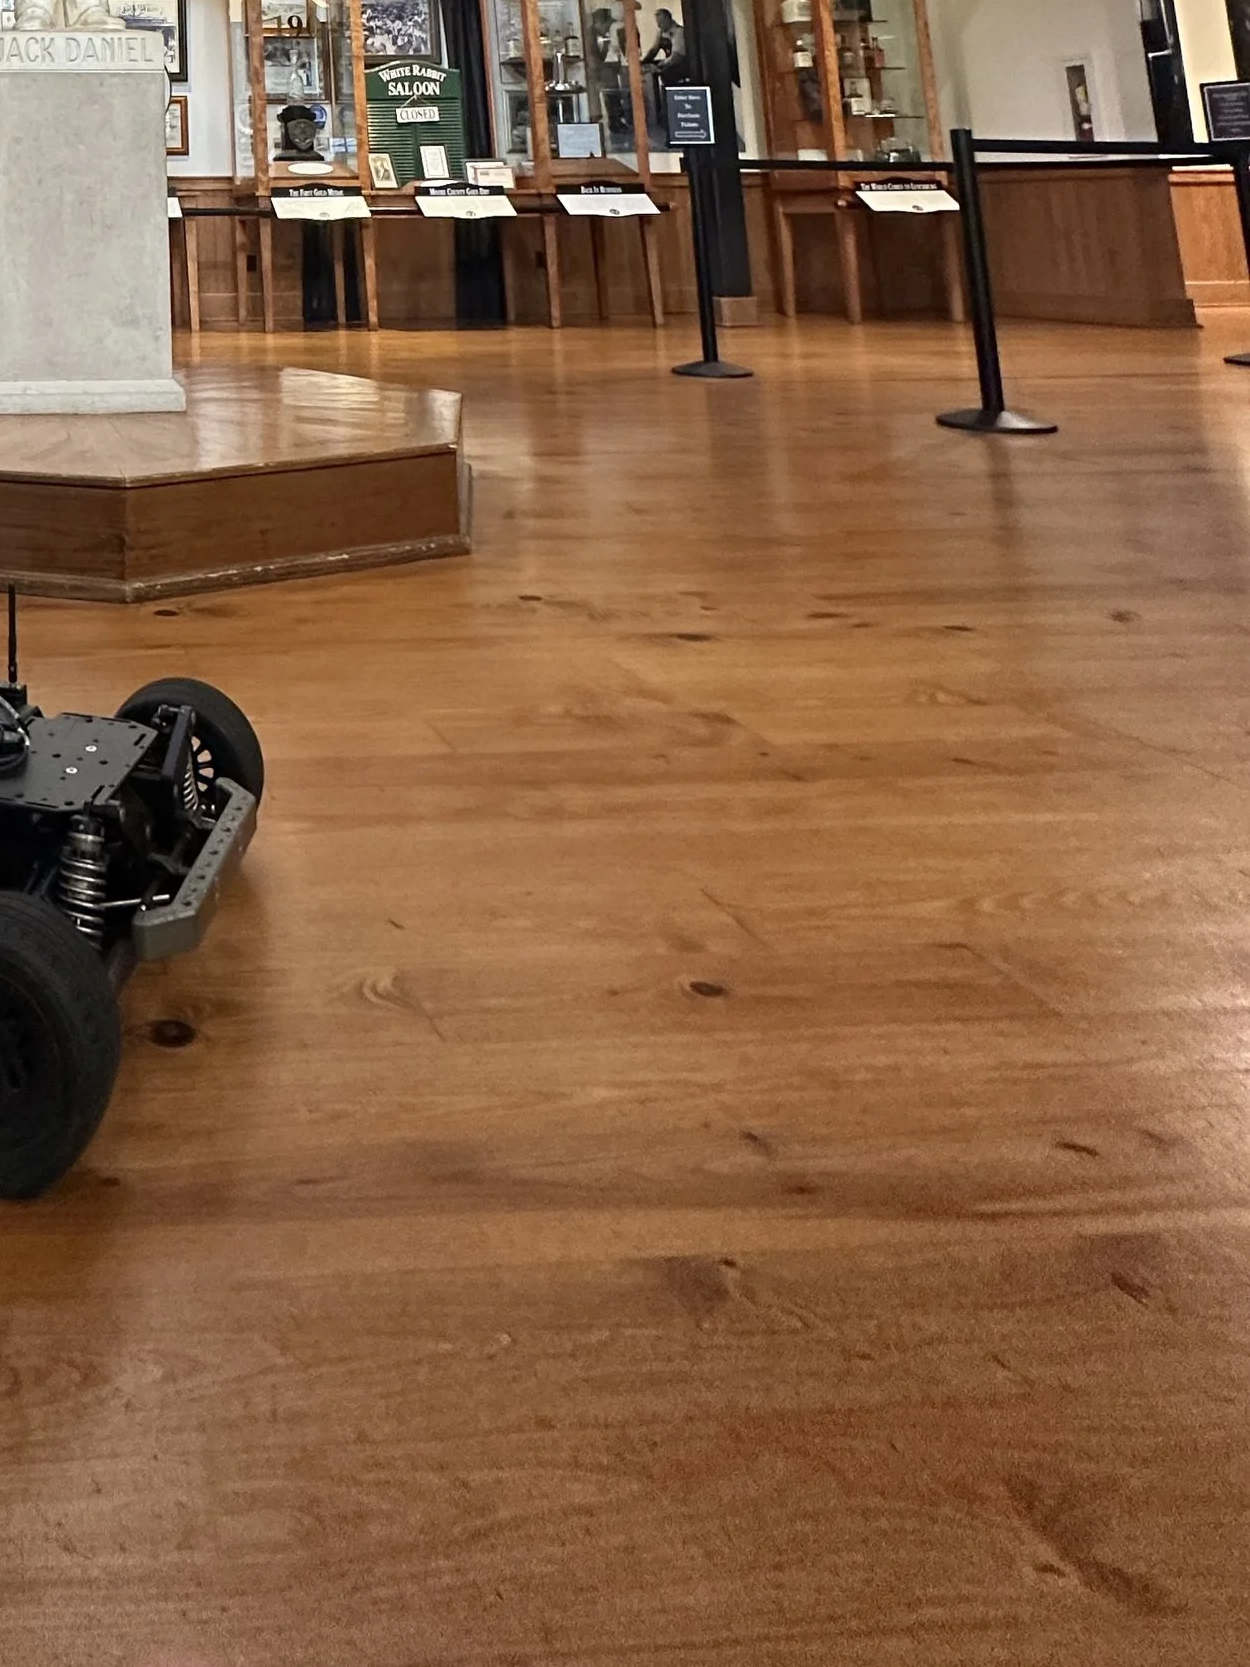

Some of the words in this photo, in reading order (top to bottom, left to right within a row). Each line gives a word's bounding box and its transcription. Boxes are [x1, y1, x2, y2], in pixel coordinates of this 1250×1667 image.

[65, 36, 155, 63] DANIEL
[378, 66, 411, 82] WHITE
[412, 64, 447, 82] RABBIT
[388, 81, 440, 96] SALOON
[399, 108, 436, 121] CLOSED
